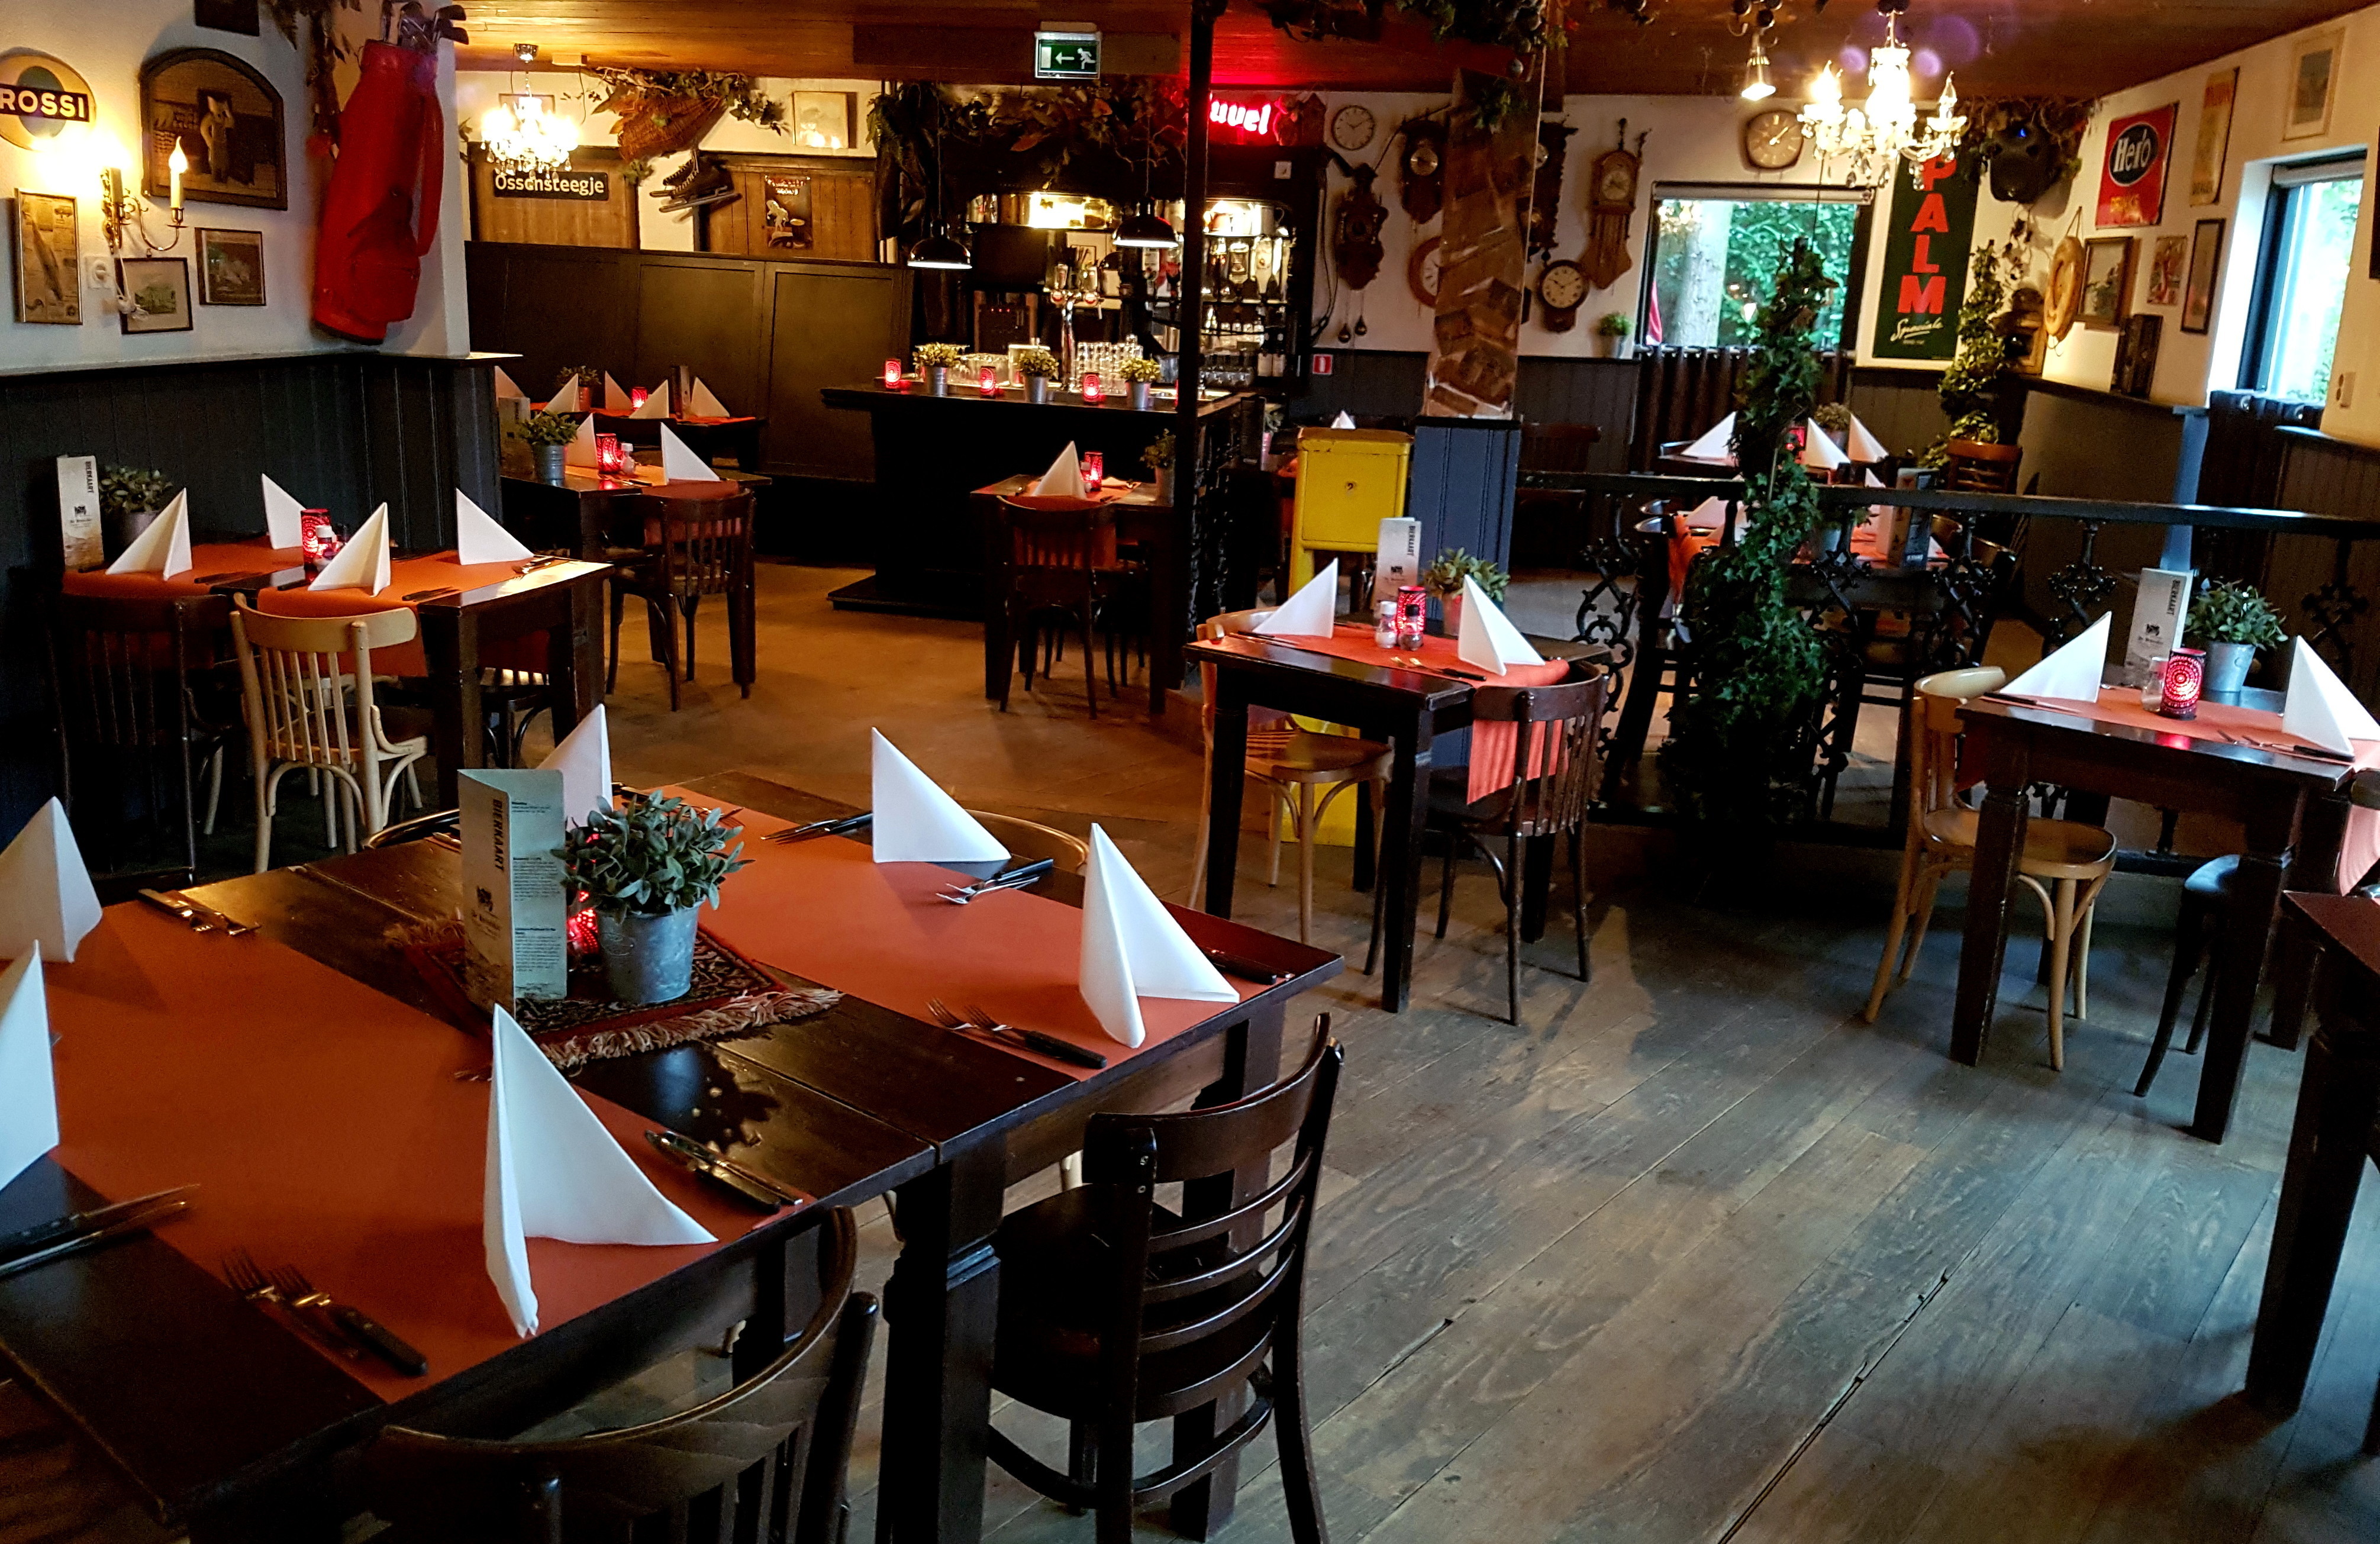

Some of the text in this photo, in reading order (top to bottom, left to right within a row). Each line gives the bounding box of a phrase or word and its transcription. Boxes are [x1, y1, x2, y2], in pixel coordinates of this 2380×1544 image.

[0, 88, 85, 118] ROSSI
[1210, 94, 1271, 135] uvel
[1897, 154, 1957, 314] PALM
[492, 799, 504, 873] BIERKAART
